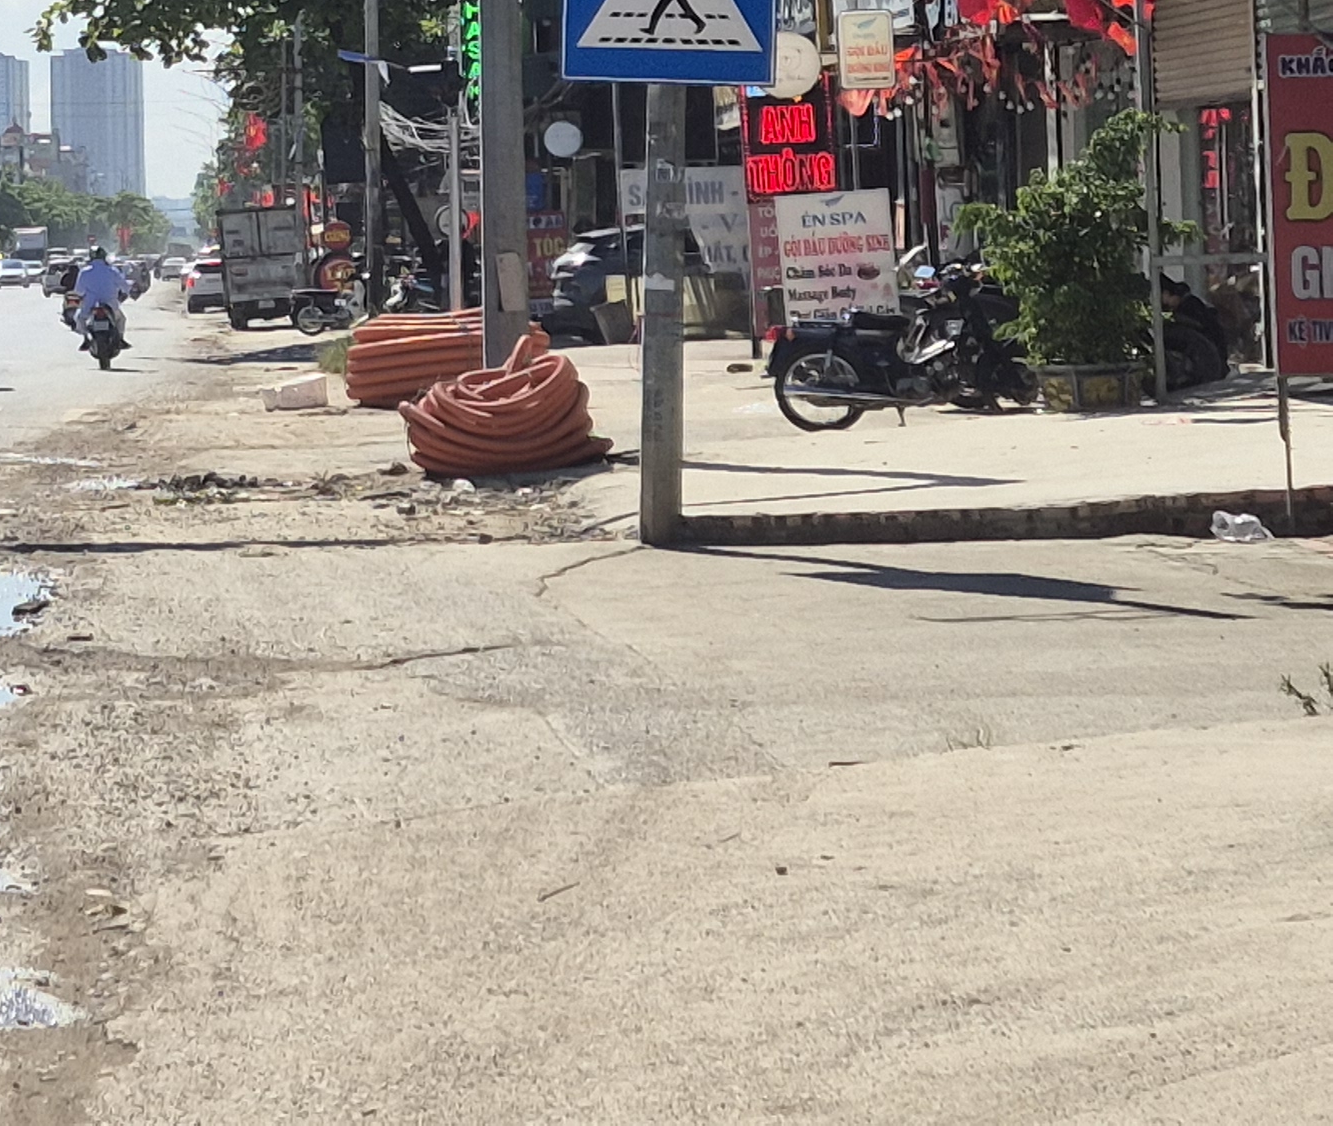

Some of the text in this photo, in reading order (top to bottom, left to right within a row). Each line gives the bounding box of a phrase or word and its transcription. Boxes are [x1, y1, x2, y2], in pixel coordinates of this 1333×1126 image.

[761, 104, 817, 144] ANH
[747, 147, 835, 193] THÔNG
[830, 211, 868, 225] SPA
